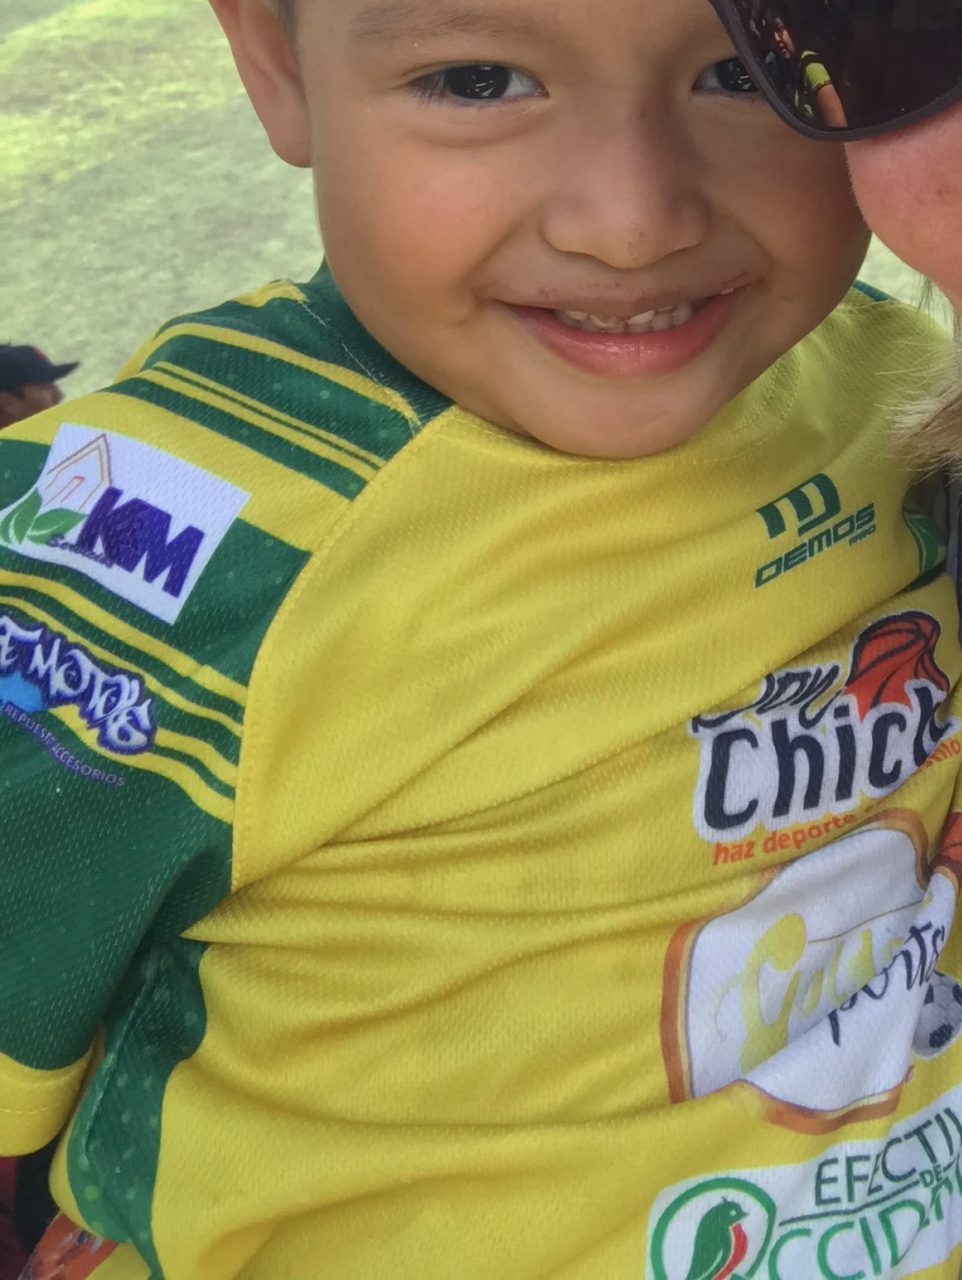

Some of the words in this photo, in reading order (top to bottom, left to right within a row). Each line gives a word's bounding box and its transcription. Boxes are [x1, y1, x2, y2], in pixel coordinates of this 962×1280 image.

[77, 485, 206, 599] KM
[754, 502, 875, 589] DEMOS
[711, 841, 756, 867] haz
